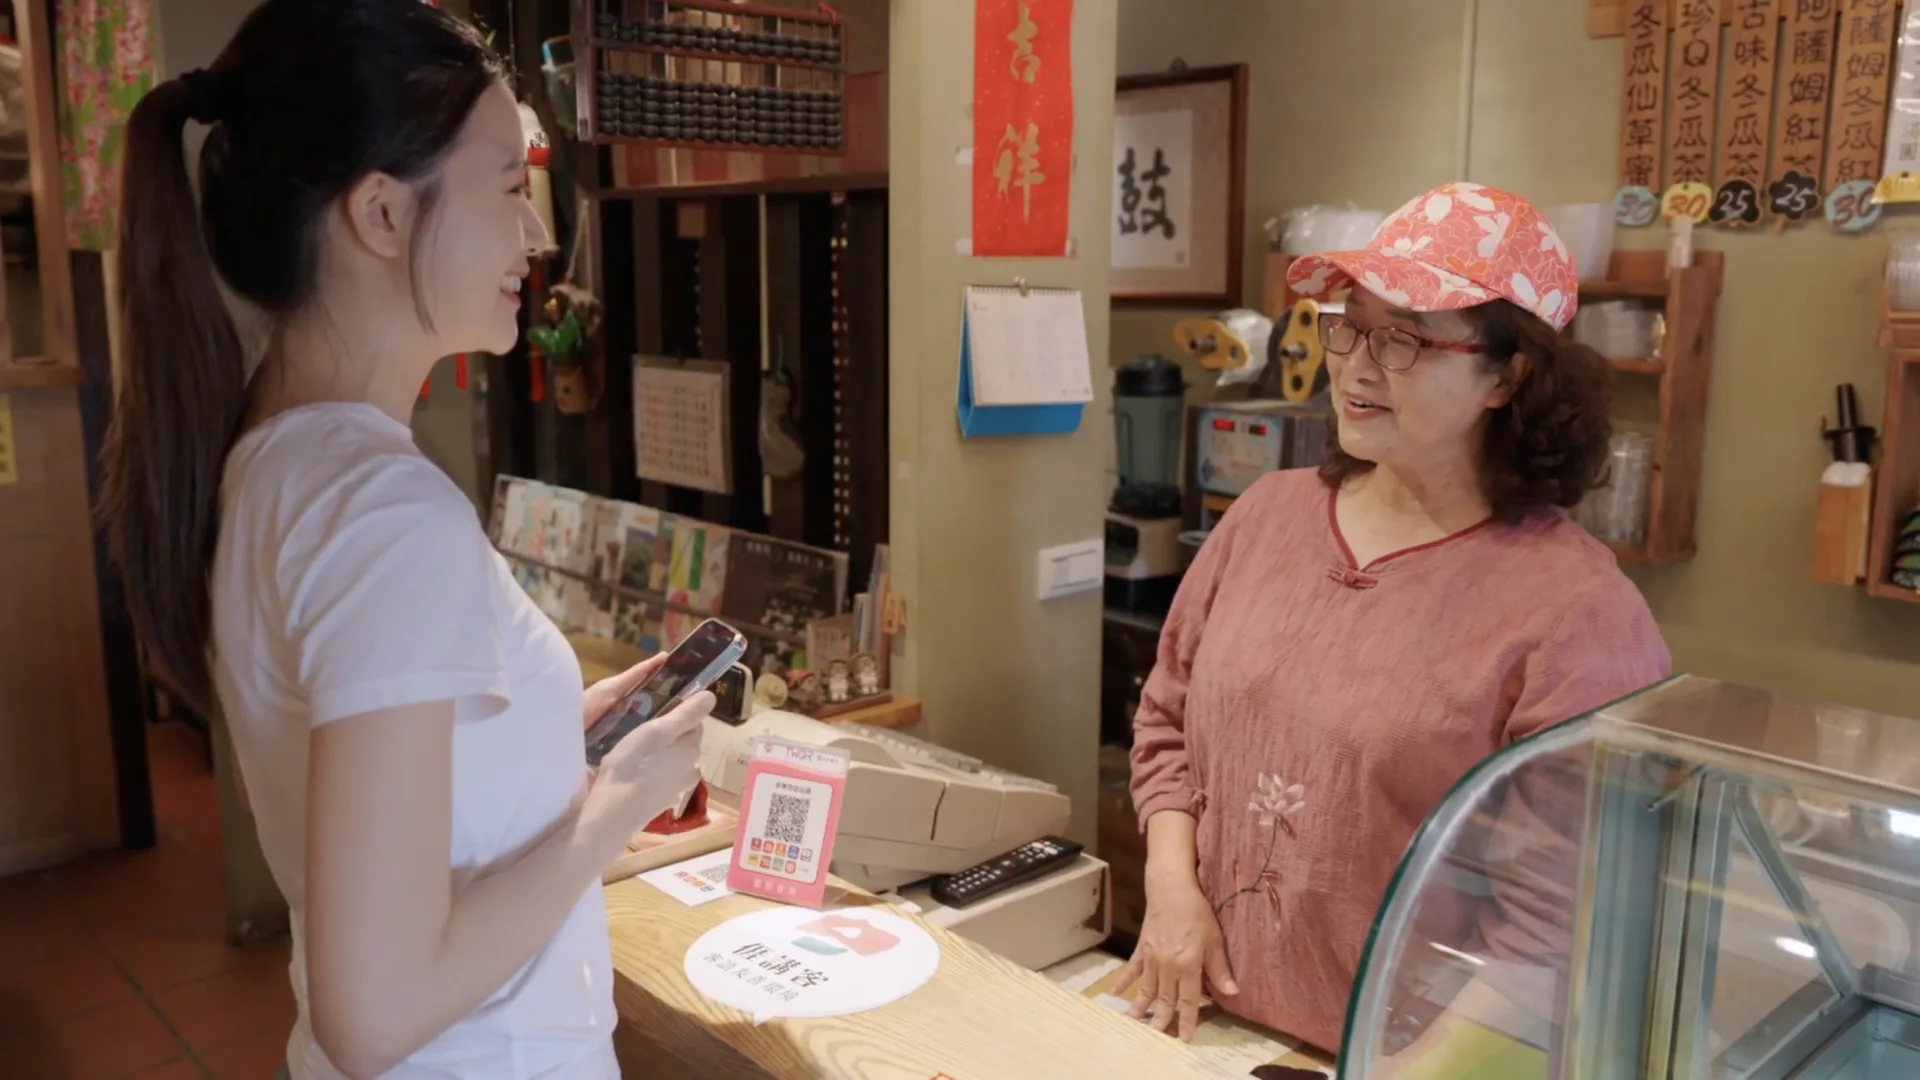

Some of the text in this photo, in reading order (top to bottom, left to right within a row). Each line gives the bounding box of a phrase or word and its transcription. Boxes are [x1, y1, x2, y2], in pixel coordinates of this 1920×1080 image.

[1837, 0, 1886, 182] 薩姆冬瓜紅
[1720, 189, 1751, 218] 25
[1775, 183, 1813, 211] 25
